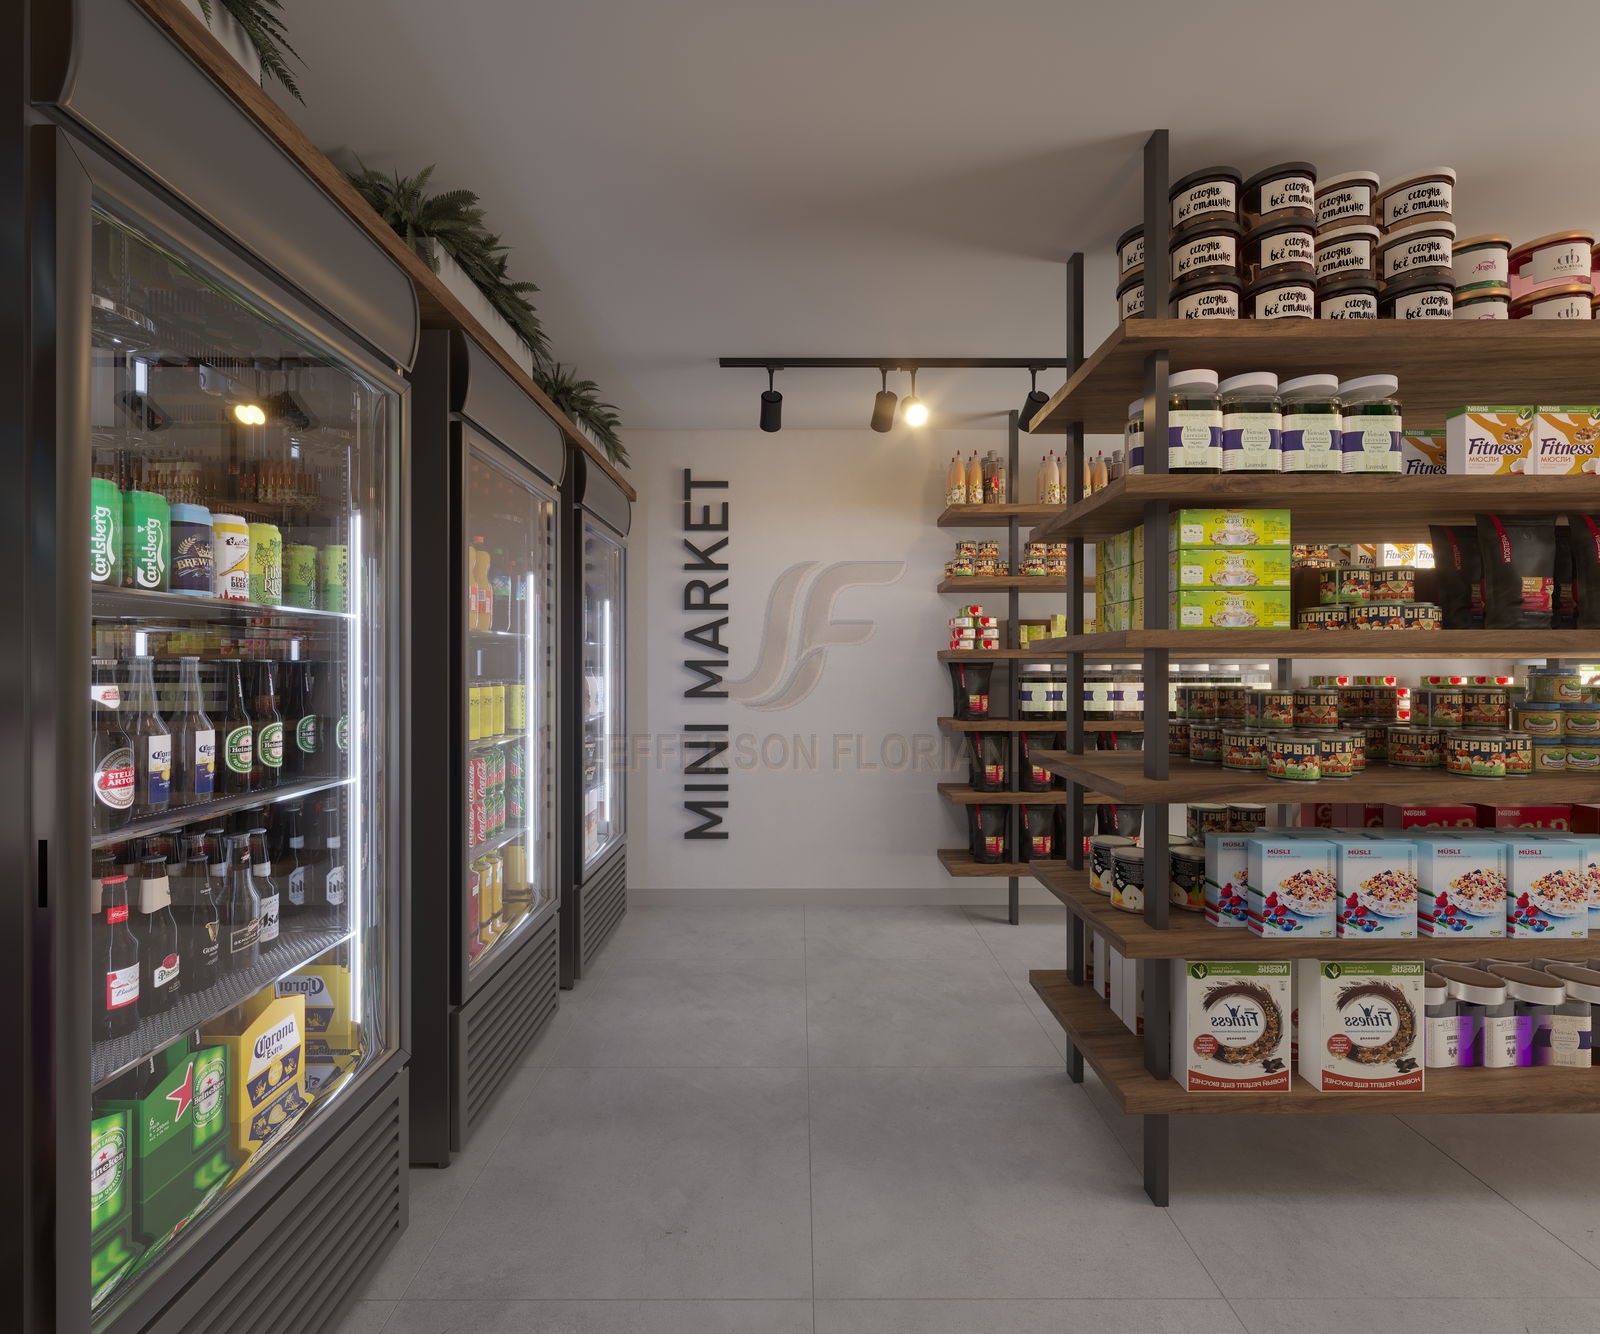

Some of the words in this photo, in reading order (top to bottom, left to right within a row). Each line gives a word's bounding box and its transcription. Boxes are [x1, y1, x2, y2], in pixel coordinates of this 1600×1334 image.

[1468, 437, 1523, 455] Fitness
[1540, 437, 1594, 455] Fitness
[137, 517, 165, 587] Carlsberg
[684, 468, 729, 698] MARKET
[1225, 737, 1267, 747] КОНСЕР
[684, 724, 729, 839] MINI
[254, 1022, 294, 1058] Corona
[267, 1044, 283, 1059] Extra
